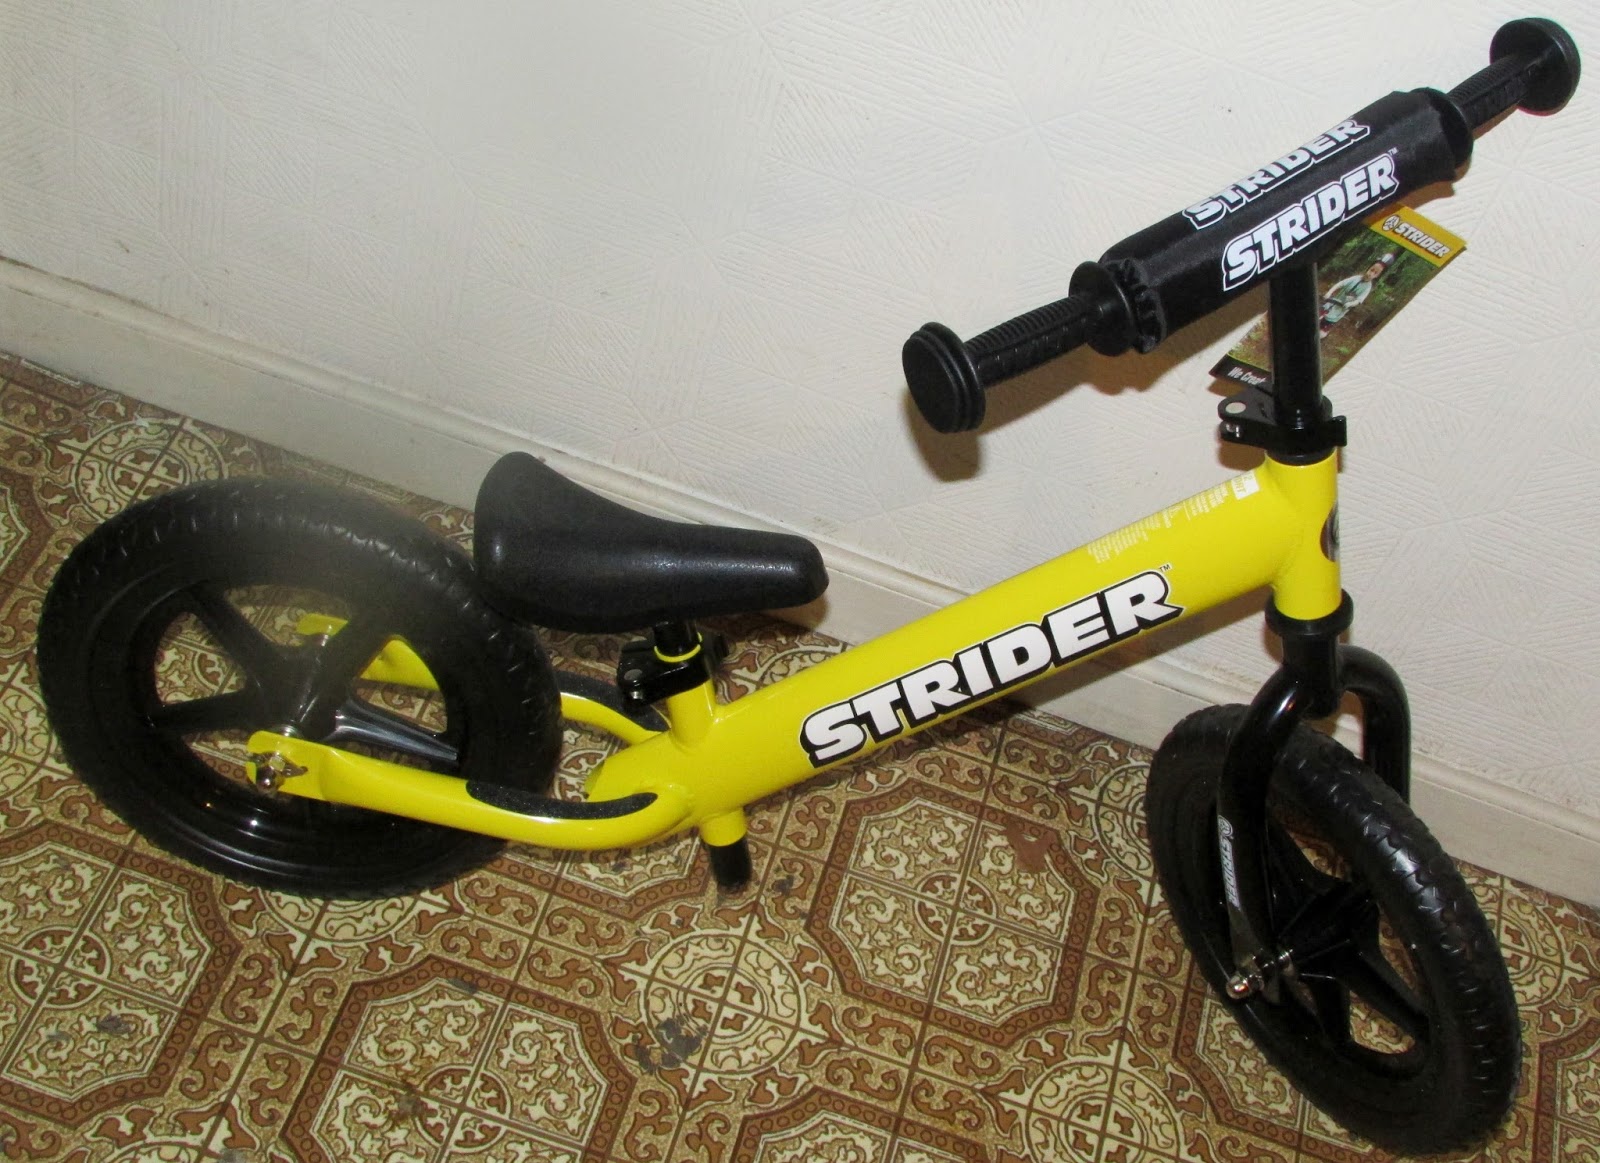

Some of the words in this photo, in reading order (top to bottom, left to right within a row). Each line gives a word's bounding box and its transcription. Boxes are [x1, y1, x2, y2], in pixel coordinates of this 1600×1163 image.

[1182, 119, 1370, 230] STRIDER
[1222, 153, 1399, 291] STRIDER
[1394, 222, 1450, 258] STRIDER
[1227, 366, 1243, 379] We
[800, 569, 1184, 769] STRIDER
[1219, 836, 1240, 909] STRIDER
